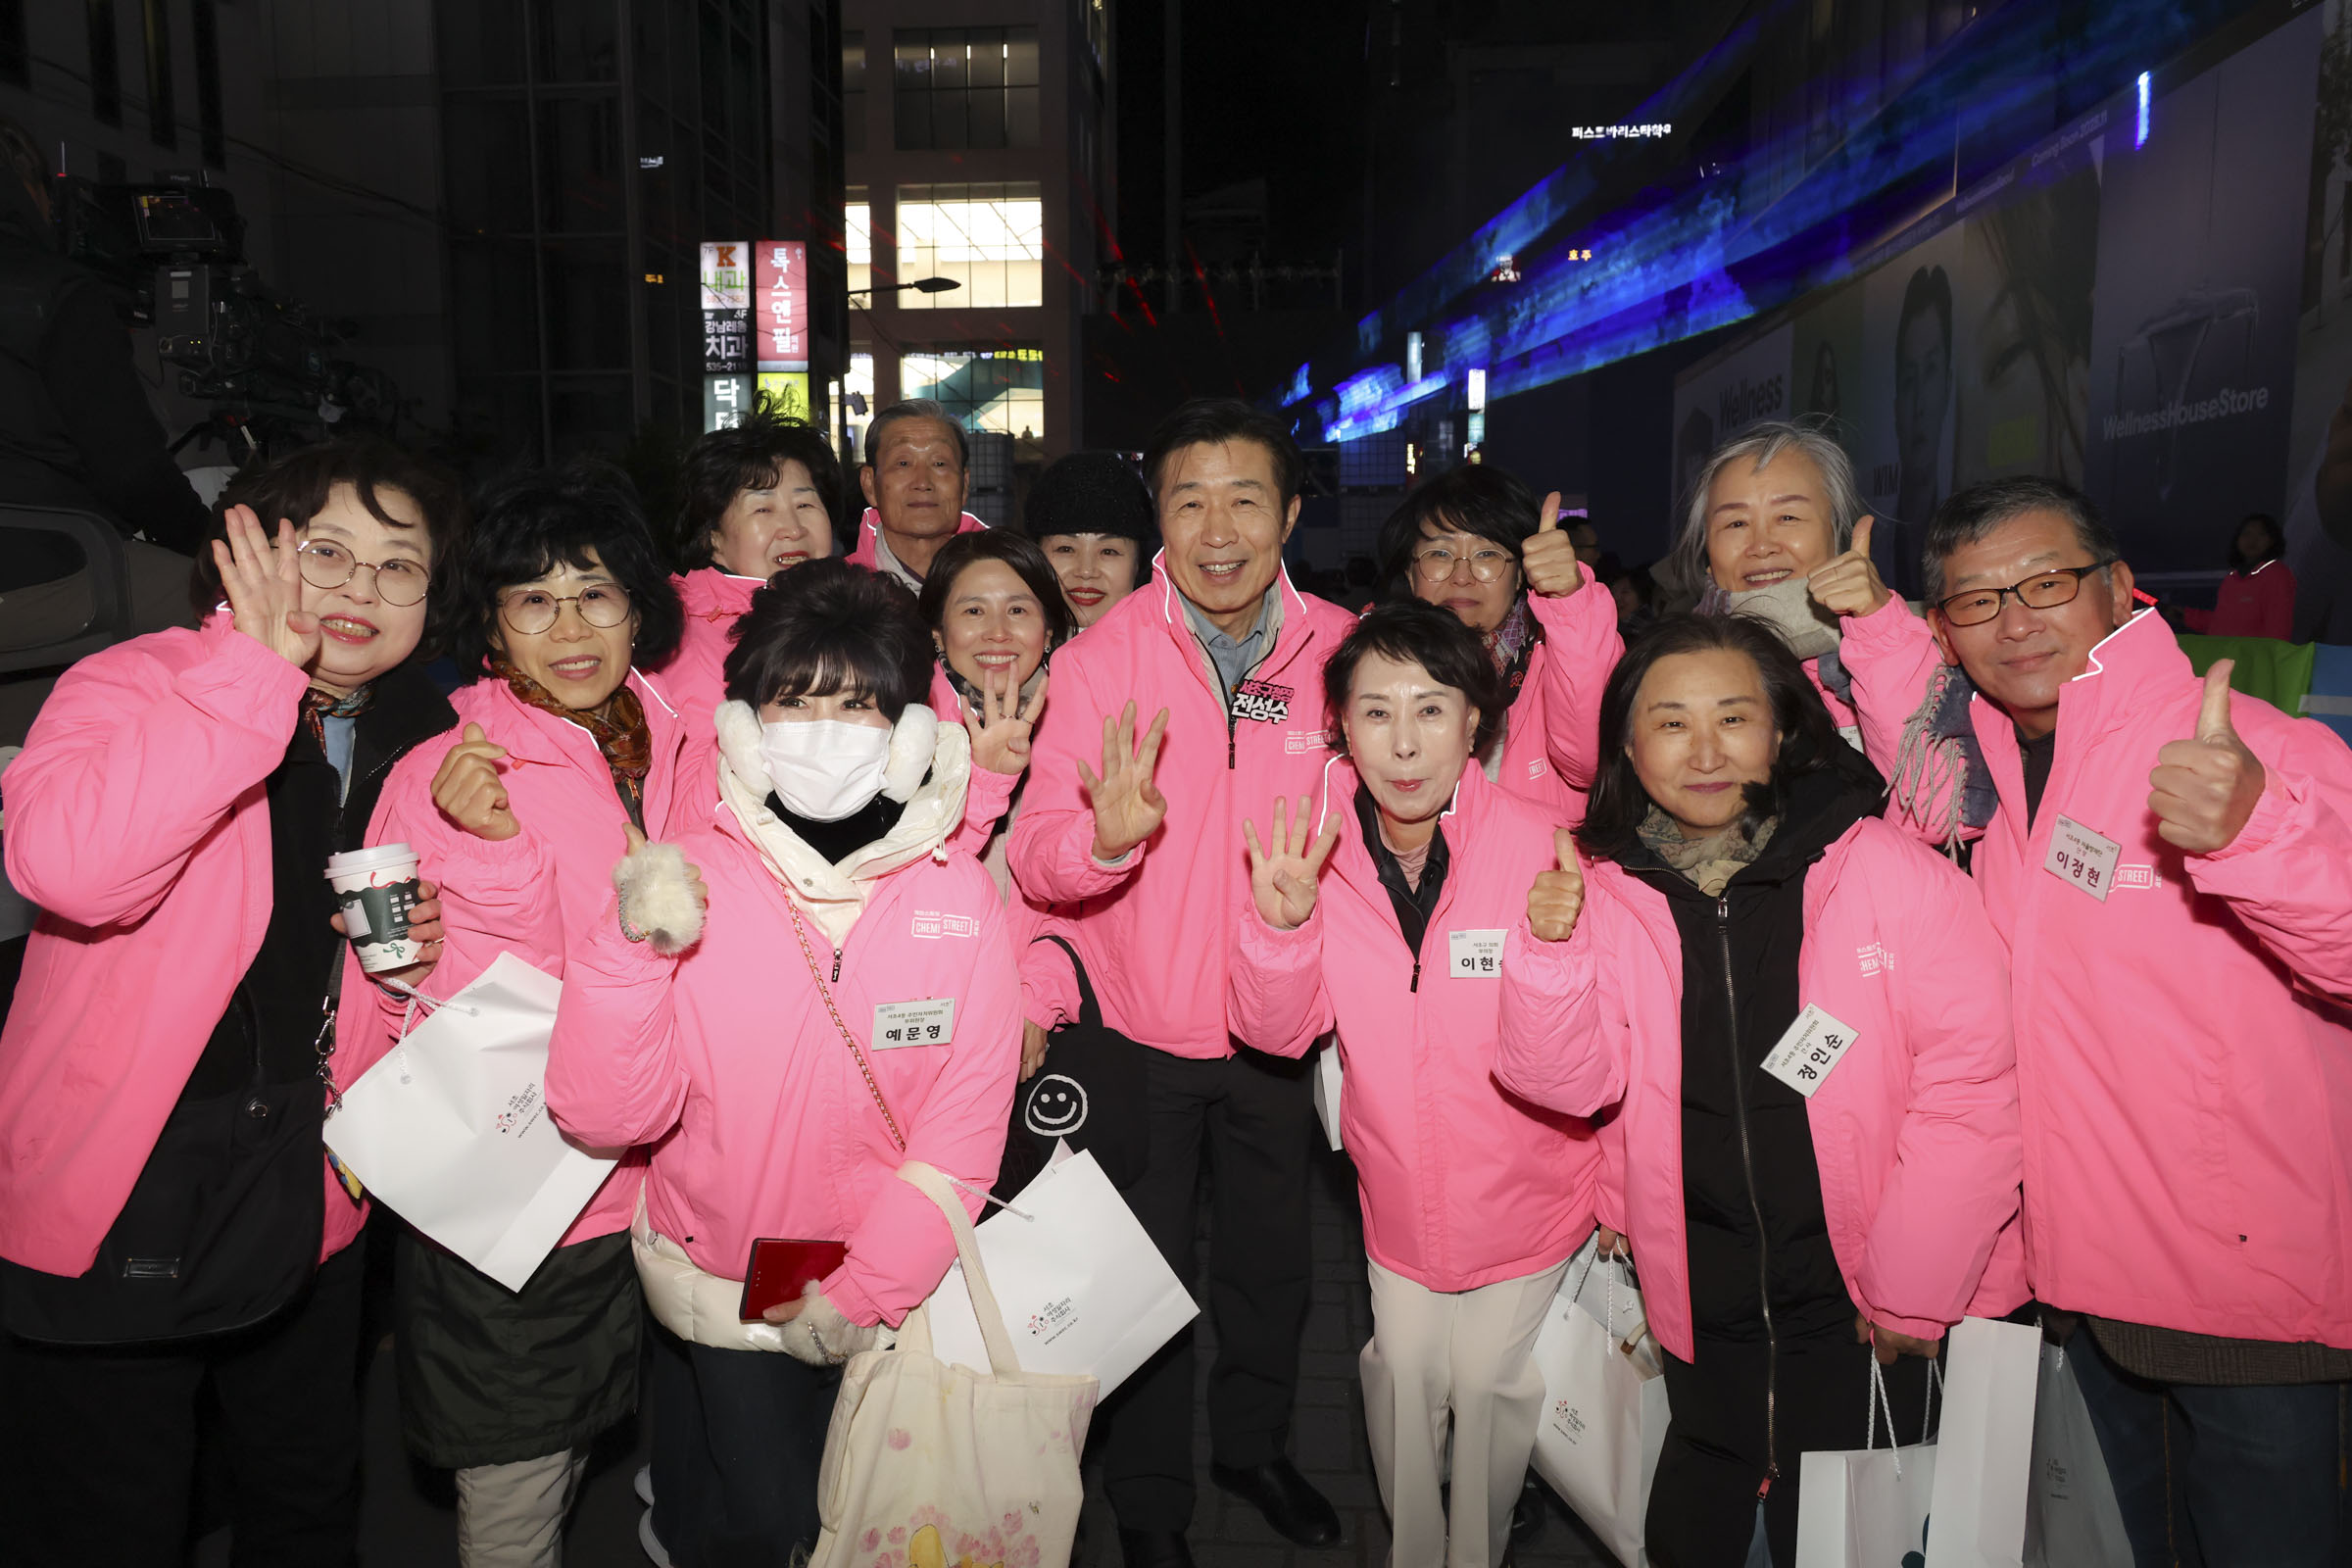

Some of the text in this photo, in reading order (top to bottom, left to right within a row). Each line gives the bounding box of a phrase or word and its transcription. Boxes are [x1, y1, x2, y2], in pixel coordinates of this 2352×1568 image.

[716, 246, 737, 267] K
[705, 335, 749, 361] 치과
[1720, 373, 1784, 432] Wellness
[2102, 385, 2270, 442] WellnessHouseStore
[1240, 679, 1296, 703] 서초구청장
[1231, 692, 1290, 724] 전성수
[2056, 851, 2101, 889] 이정현
[2117, 869, 2149, 883] STREET
[915, 922, 941, 934] CHEMI
[943, 917, 969, 934] STREET
[885, 1024, 941, 1042] 예문영
[1796, 1034, 1843, 1080] 정인순
